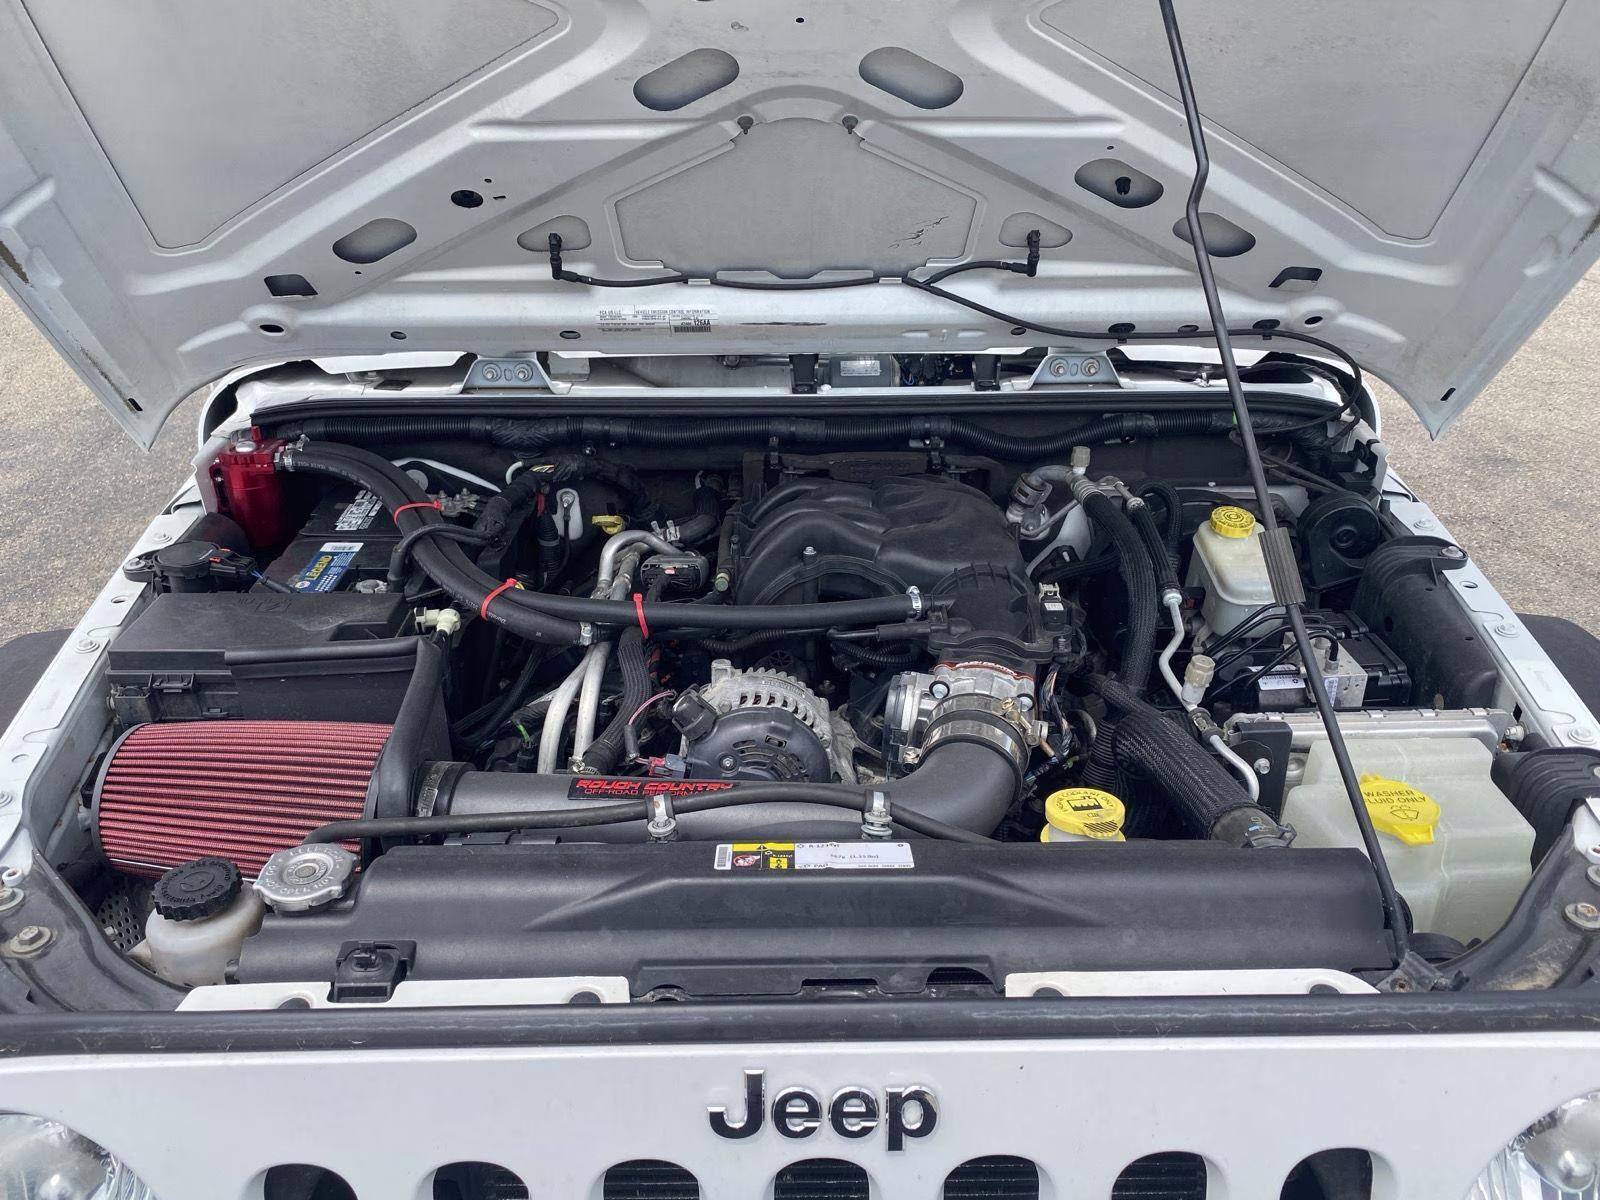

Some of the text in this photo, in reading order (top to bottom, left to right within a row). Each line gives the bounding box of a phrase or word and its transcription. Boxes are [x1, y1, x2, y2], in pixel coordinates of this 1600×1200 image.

[304, 555, 332, 580] LEGEND
[576, 779, 733, 791] ROUGH COUNTRY
[706, 1068, 939, 1152] Jeep
